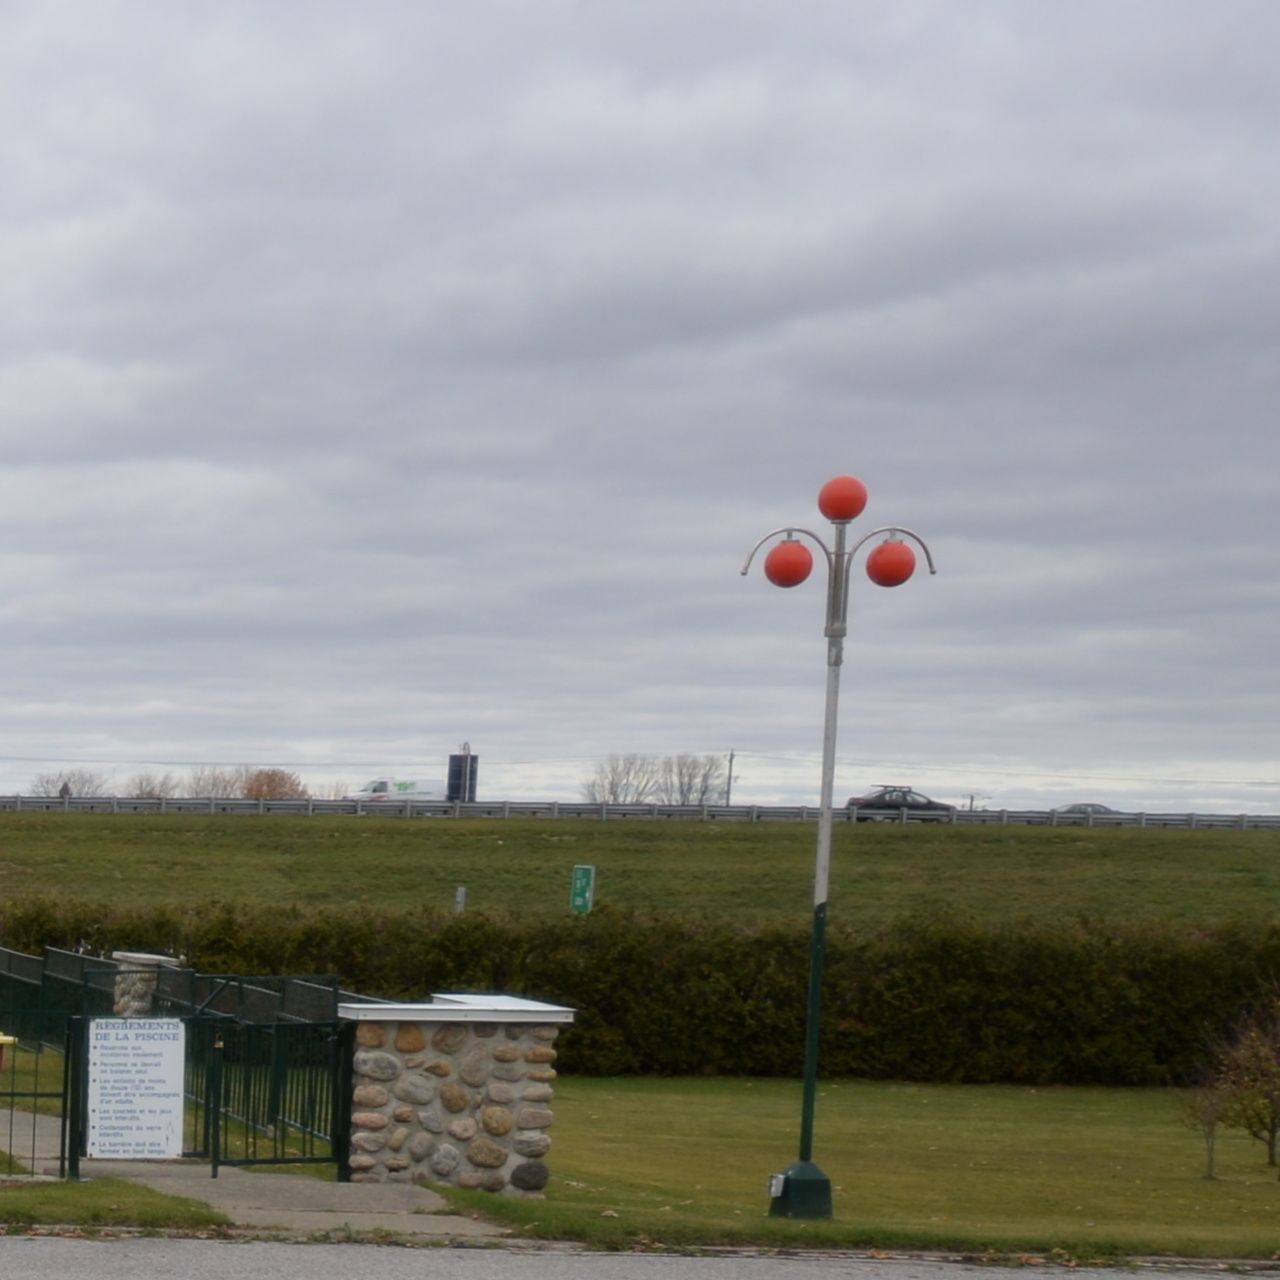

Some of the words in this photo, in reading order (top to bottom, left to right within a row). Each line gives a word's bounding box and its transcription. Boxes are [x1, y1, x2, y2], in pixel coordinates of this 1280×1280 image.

[95, 1033, 110, 1041] DE
[115, 1033, 129, 1041] LA
[135, 1033, 179, 1041] PISCINE
